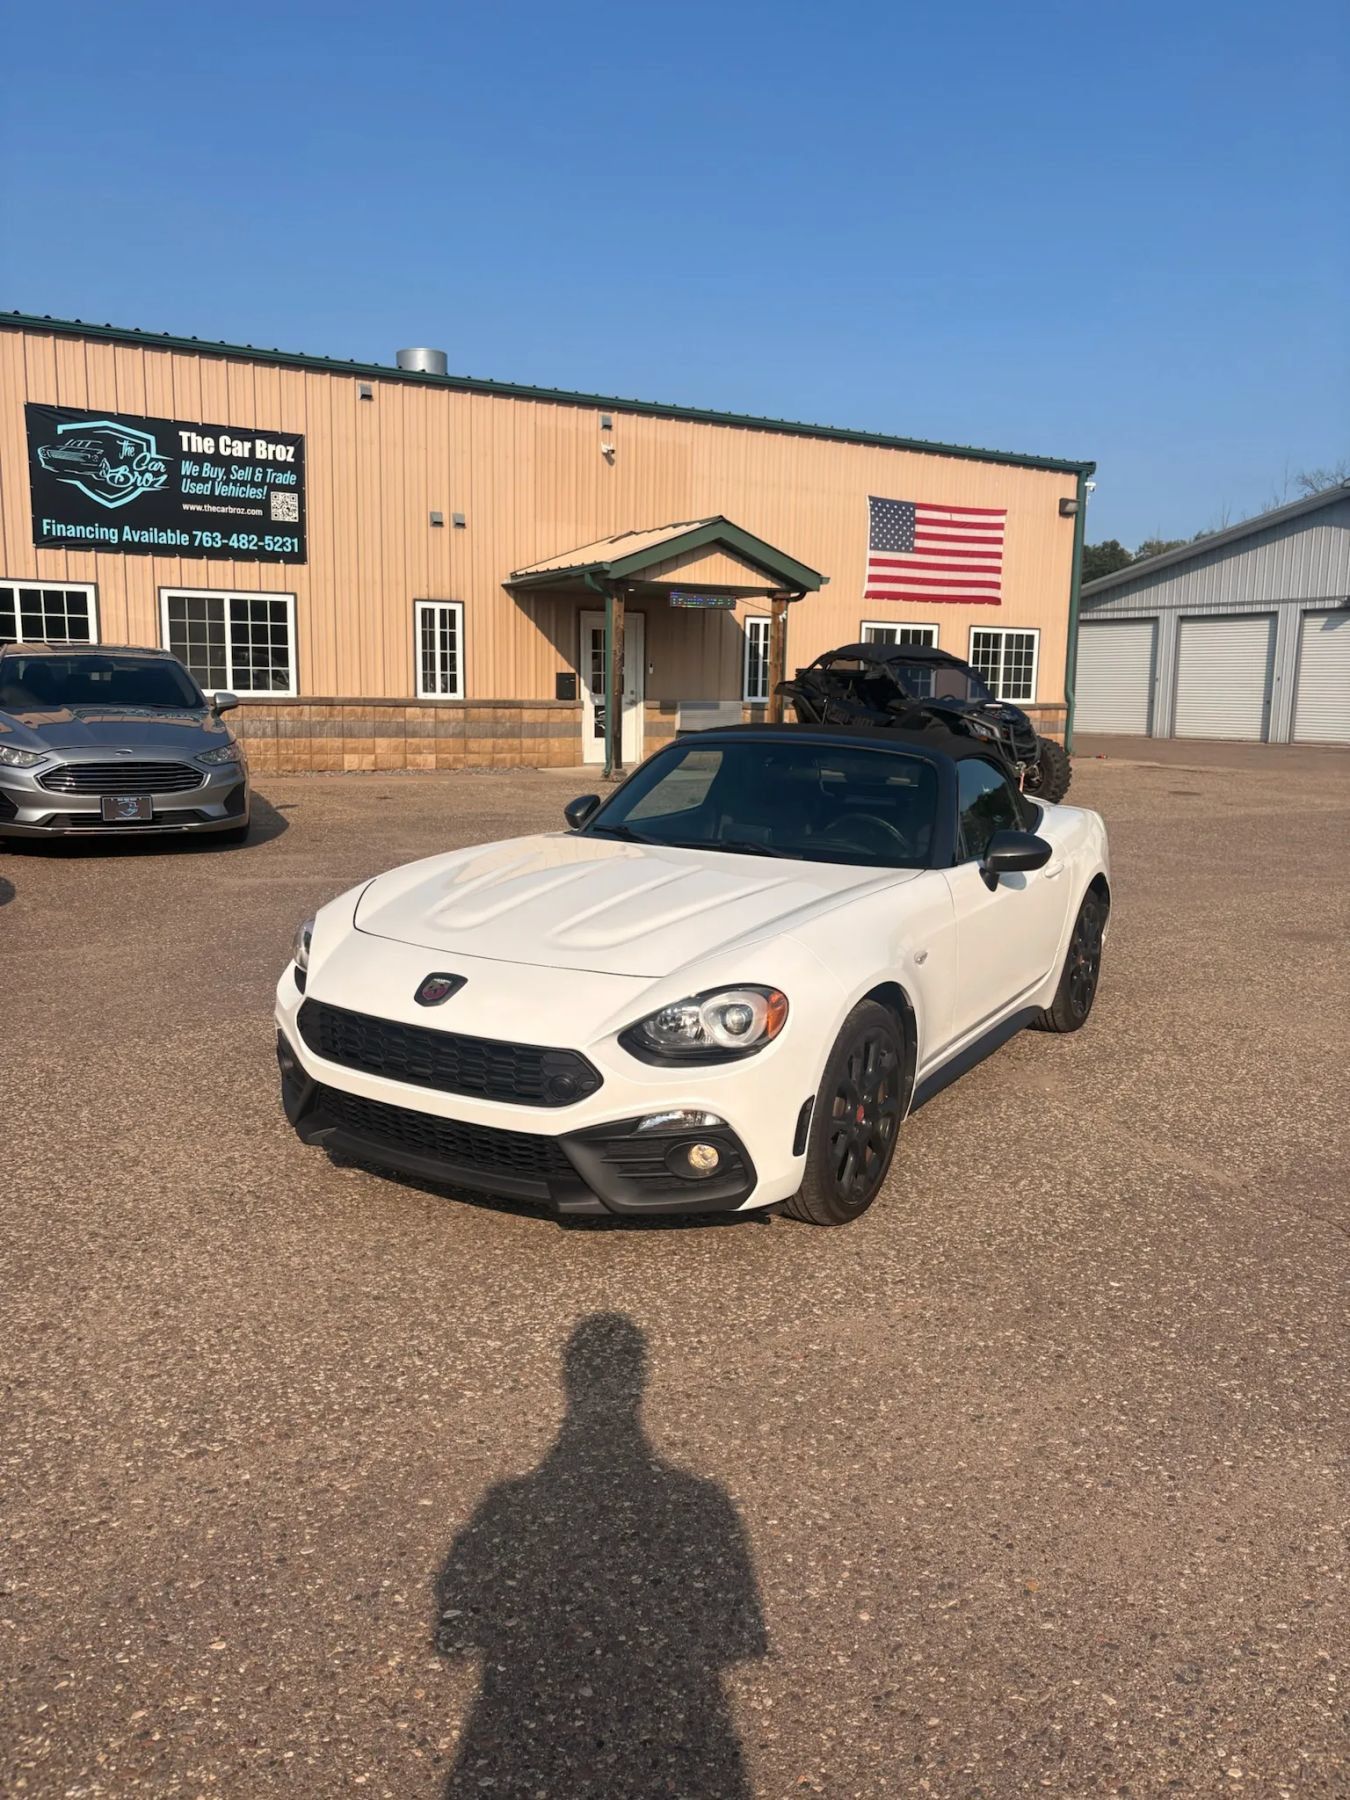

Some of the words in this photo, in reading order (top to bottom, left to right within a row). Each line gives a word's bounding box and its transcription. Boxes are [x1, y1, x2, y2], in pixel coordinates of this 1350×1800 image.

[116, 440, 135, 459] The
[178, 431, 215, 454] The
[219, 435, 252, 457] Car
[255, 439, 295, 462] Broz
[133, 452, 166, 472] Car
[181, 460, 200, 476] We
[202, 462, 226, 481] Buy,
[230, 465, 252, 481] Sell
[254, 467, 263, 482] &
[266, 468, 297, 485] Trade
[107, 465, 168, 488] Broz
[181, 478, 212, 495] Used
[214, 481, 268, 499] Vehicles!
[182, 503, 263, 516] www.thecarbroz.com
[42, 519, 118, 543] Financing
[122, 526, 189, 545] Available
[192, 531, 298, 552] 763-482-5231
